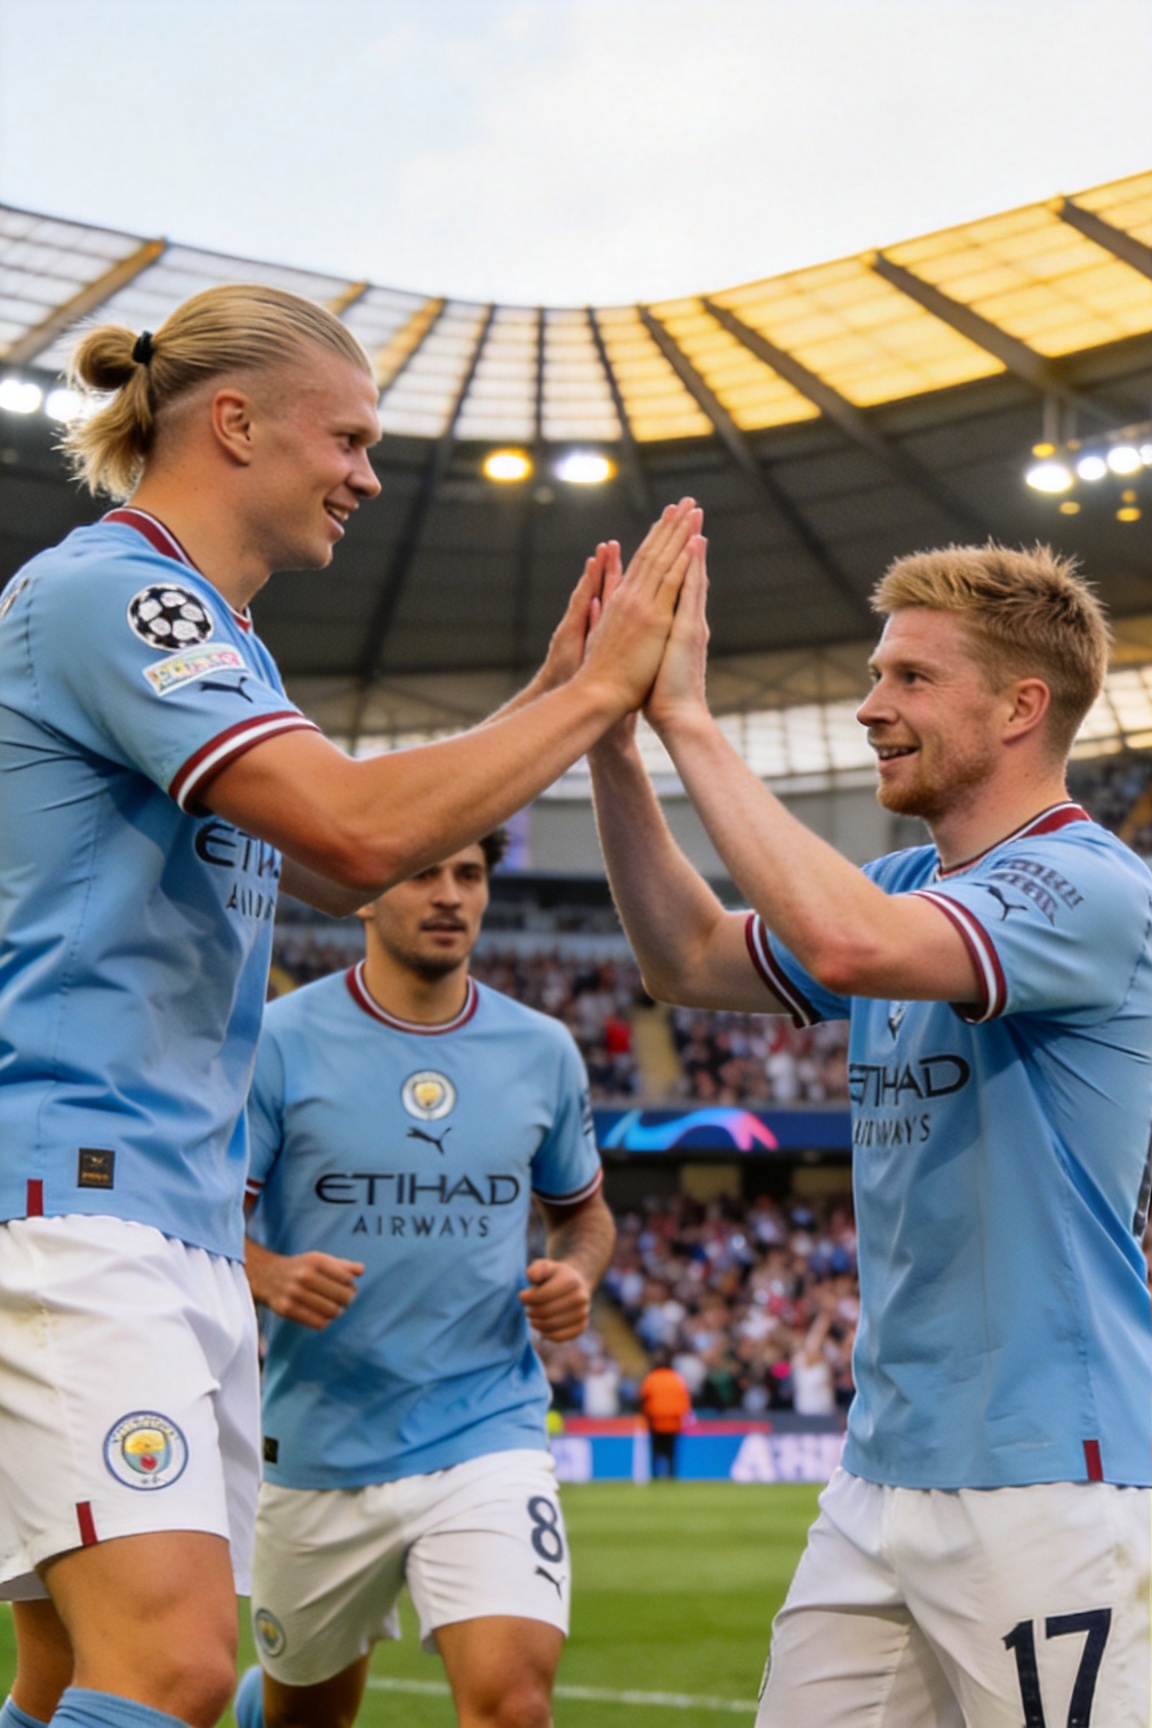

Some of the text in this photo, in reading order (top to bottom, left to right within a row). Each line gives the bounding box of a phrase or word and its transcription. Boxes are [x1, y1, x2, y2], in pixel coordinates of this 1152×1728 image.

[315, 1173, 521, 1206] ETIHAD
[352, 1214, 492, 1238] AIRWAYS
[527, 1495, 564, 1564] 8
[1001, 1607, 1112, 1728] 17
